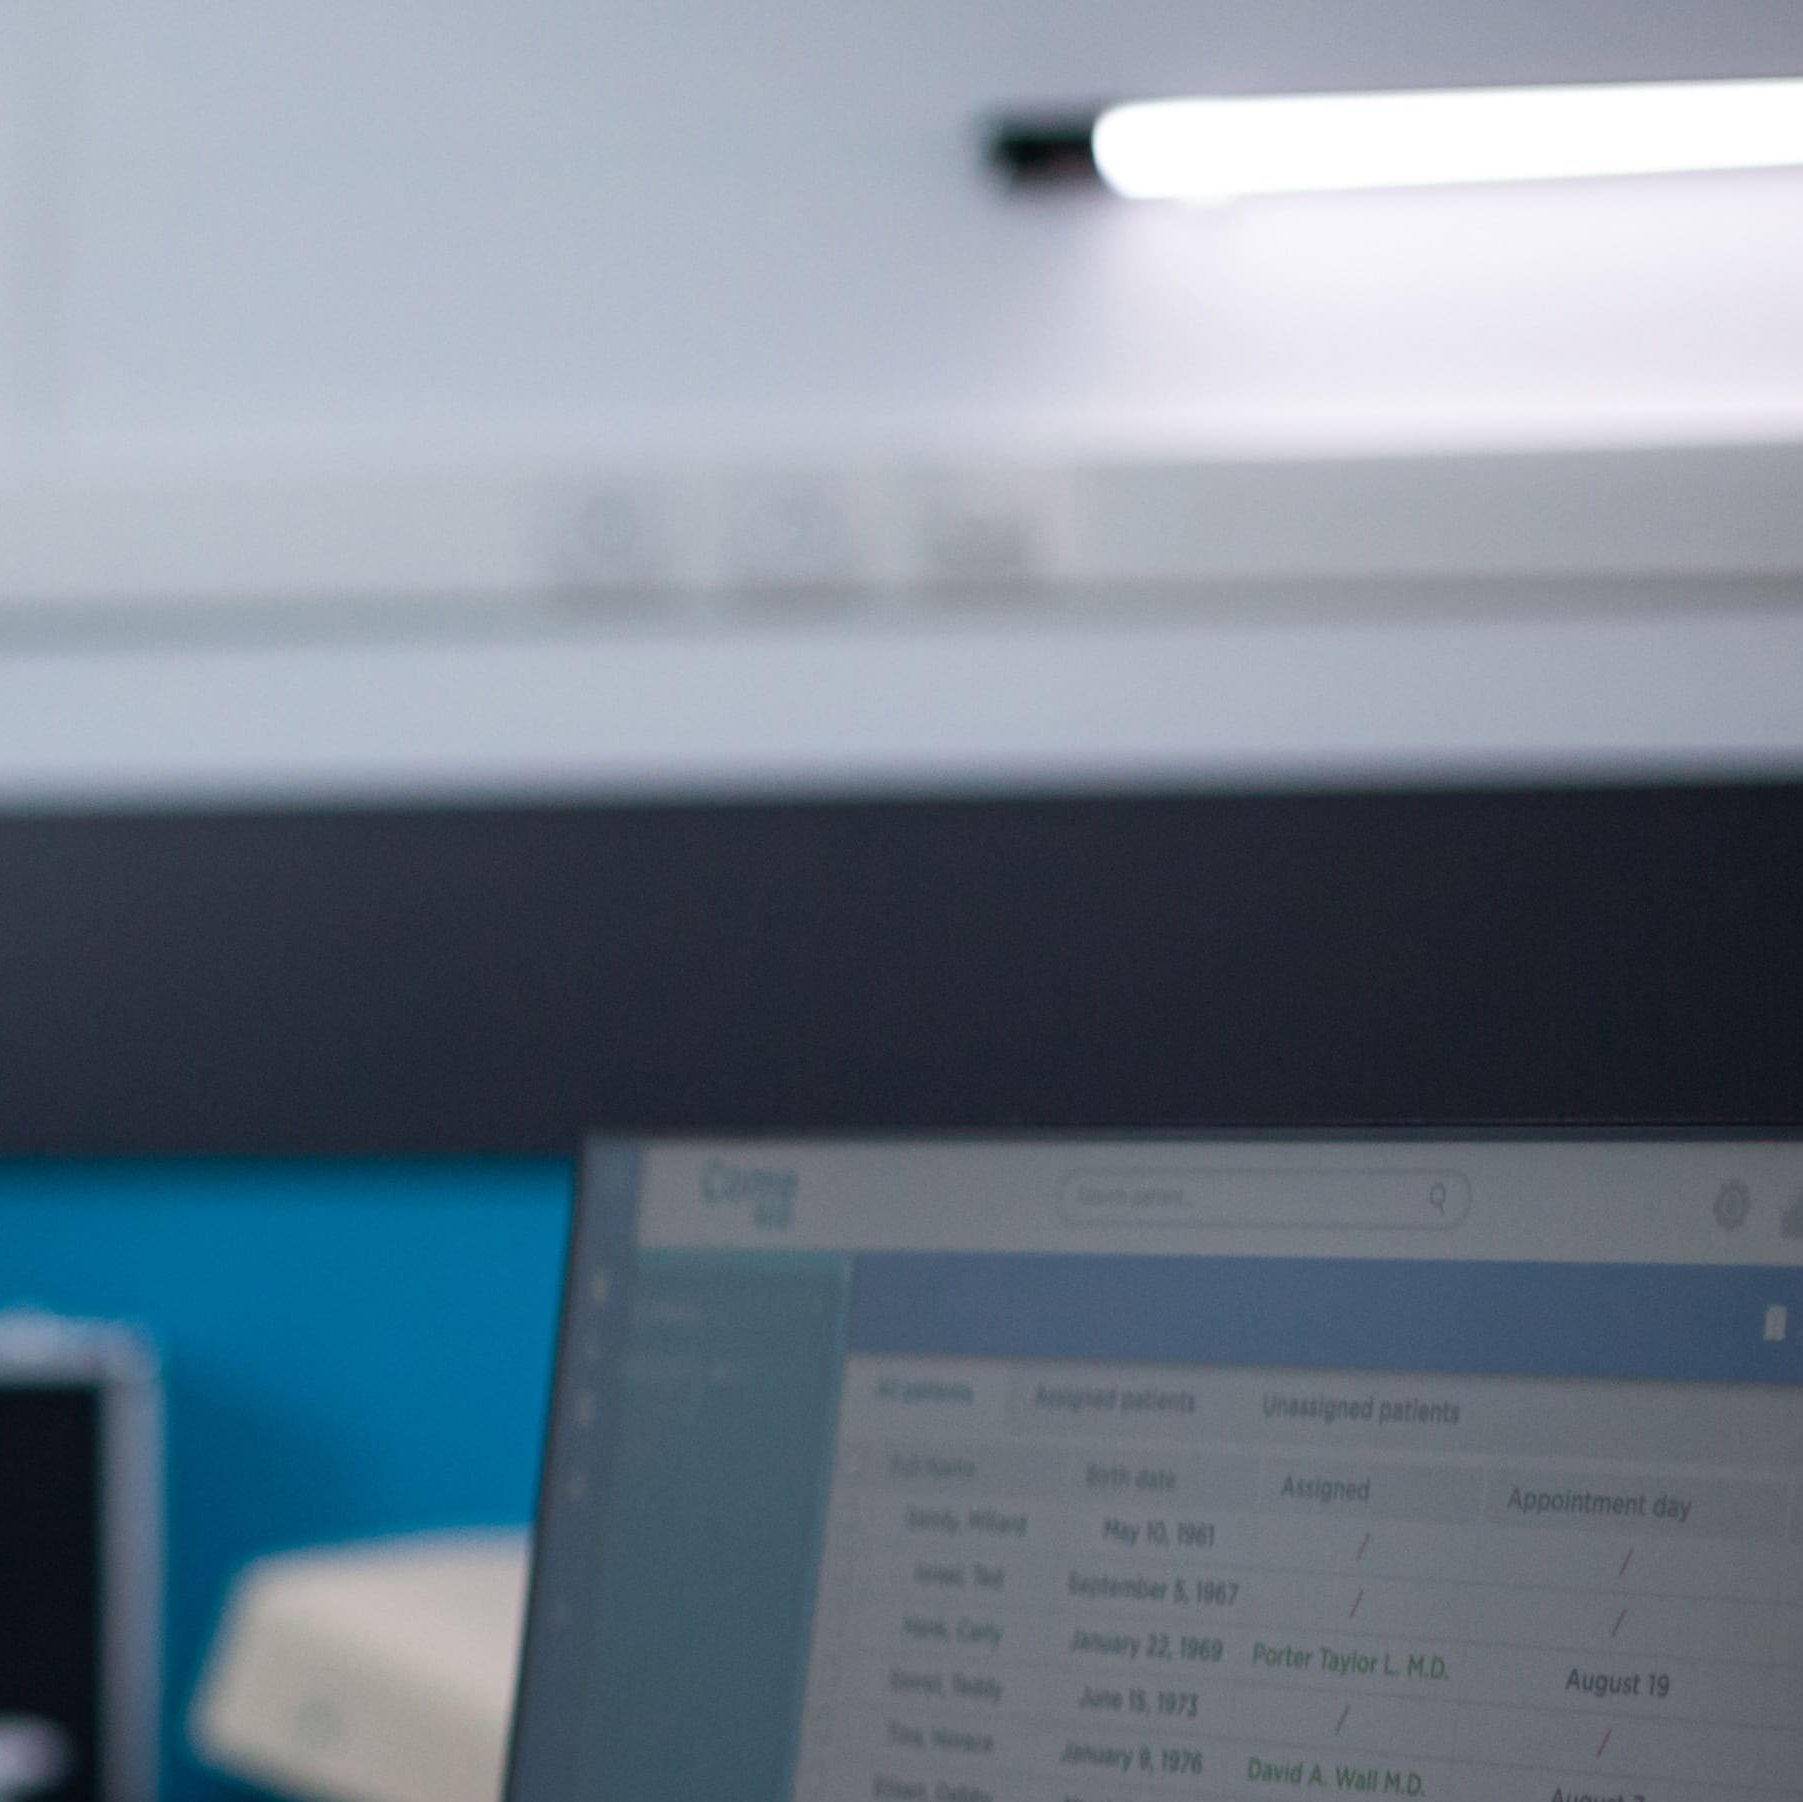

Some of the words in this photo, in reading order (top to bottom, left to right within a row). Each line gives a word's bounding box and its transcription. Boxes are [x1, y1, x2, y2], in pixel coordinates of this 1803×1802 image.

[1035, 1383, 1117, 1412] Assigned
[1120, 1388, 1196, 1415] patients
[1263, 1393, 1375, 1424] Unassigned
[1378, 1397, 1461, 1426] patients
[1086, 1464, 1130, 1488] Birth
[1134, 1467, 1177, 1491] date
[1281, 1474, 1371, 1506] Assigned
[1507, 1487, 1647, 1519] Appointment
[1652, 1494, 1694, 1524] day
[1103, 1517, 1140, 1546] May
[1177, 1522, 1217, 1548] 1961
[1067, 1570, 1169, 1600] September
[1196, 1580, 1240, 1607] 1967
[1068, 1627, 1141, 1659] January
[1180, 1635, 1225, 1663] 1969
[1251, 1641, 1313, 1671] Porter
[1320, 1647, 1378, 1678] Taylor
[1383, 1653, 1400, 1678] L.
[1407, 1654, 1451, 1682] M.D.
[1565, 1667, 1641, 1699] August
[1648, 1674, 1672, 1699] 19
[1078, 1684, 1123, 1711] June
[1157, 1691, 1200, 1719] 1973
[1060, 1740, 1132, 1773] January
[1162, 1748, 1205, 1776] 1976
[1247, 1756, 1304, 1786] David
[1308, 1763, 1328, 1788] A.
[1336, 1765, 1379, 1793] Wall
[1383, 1771, 1426, 1798] M.D.
